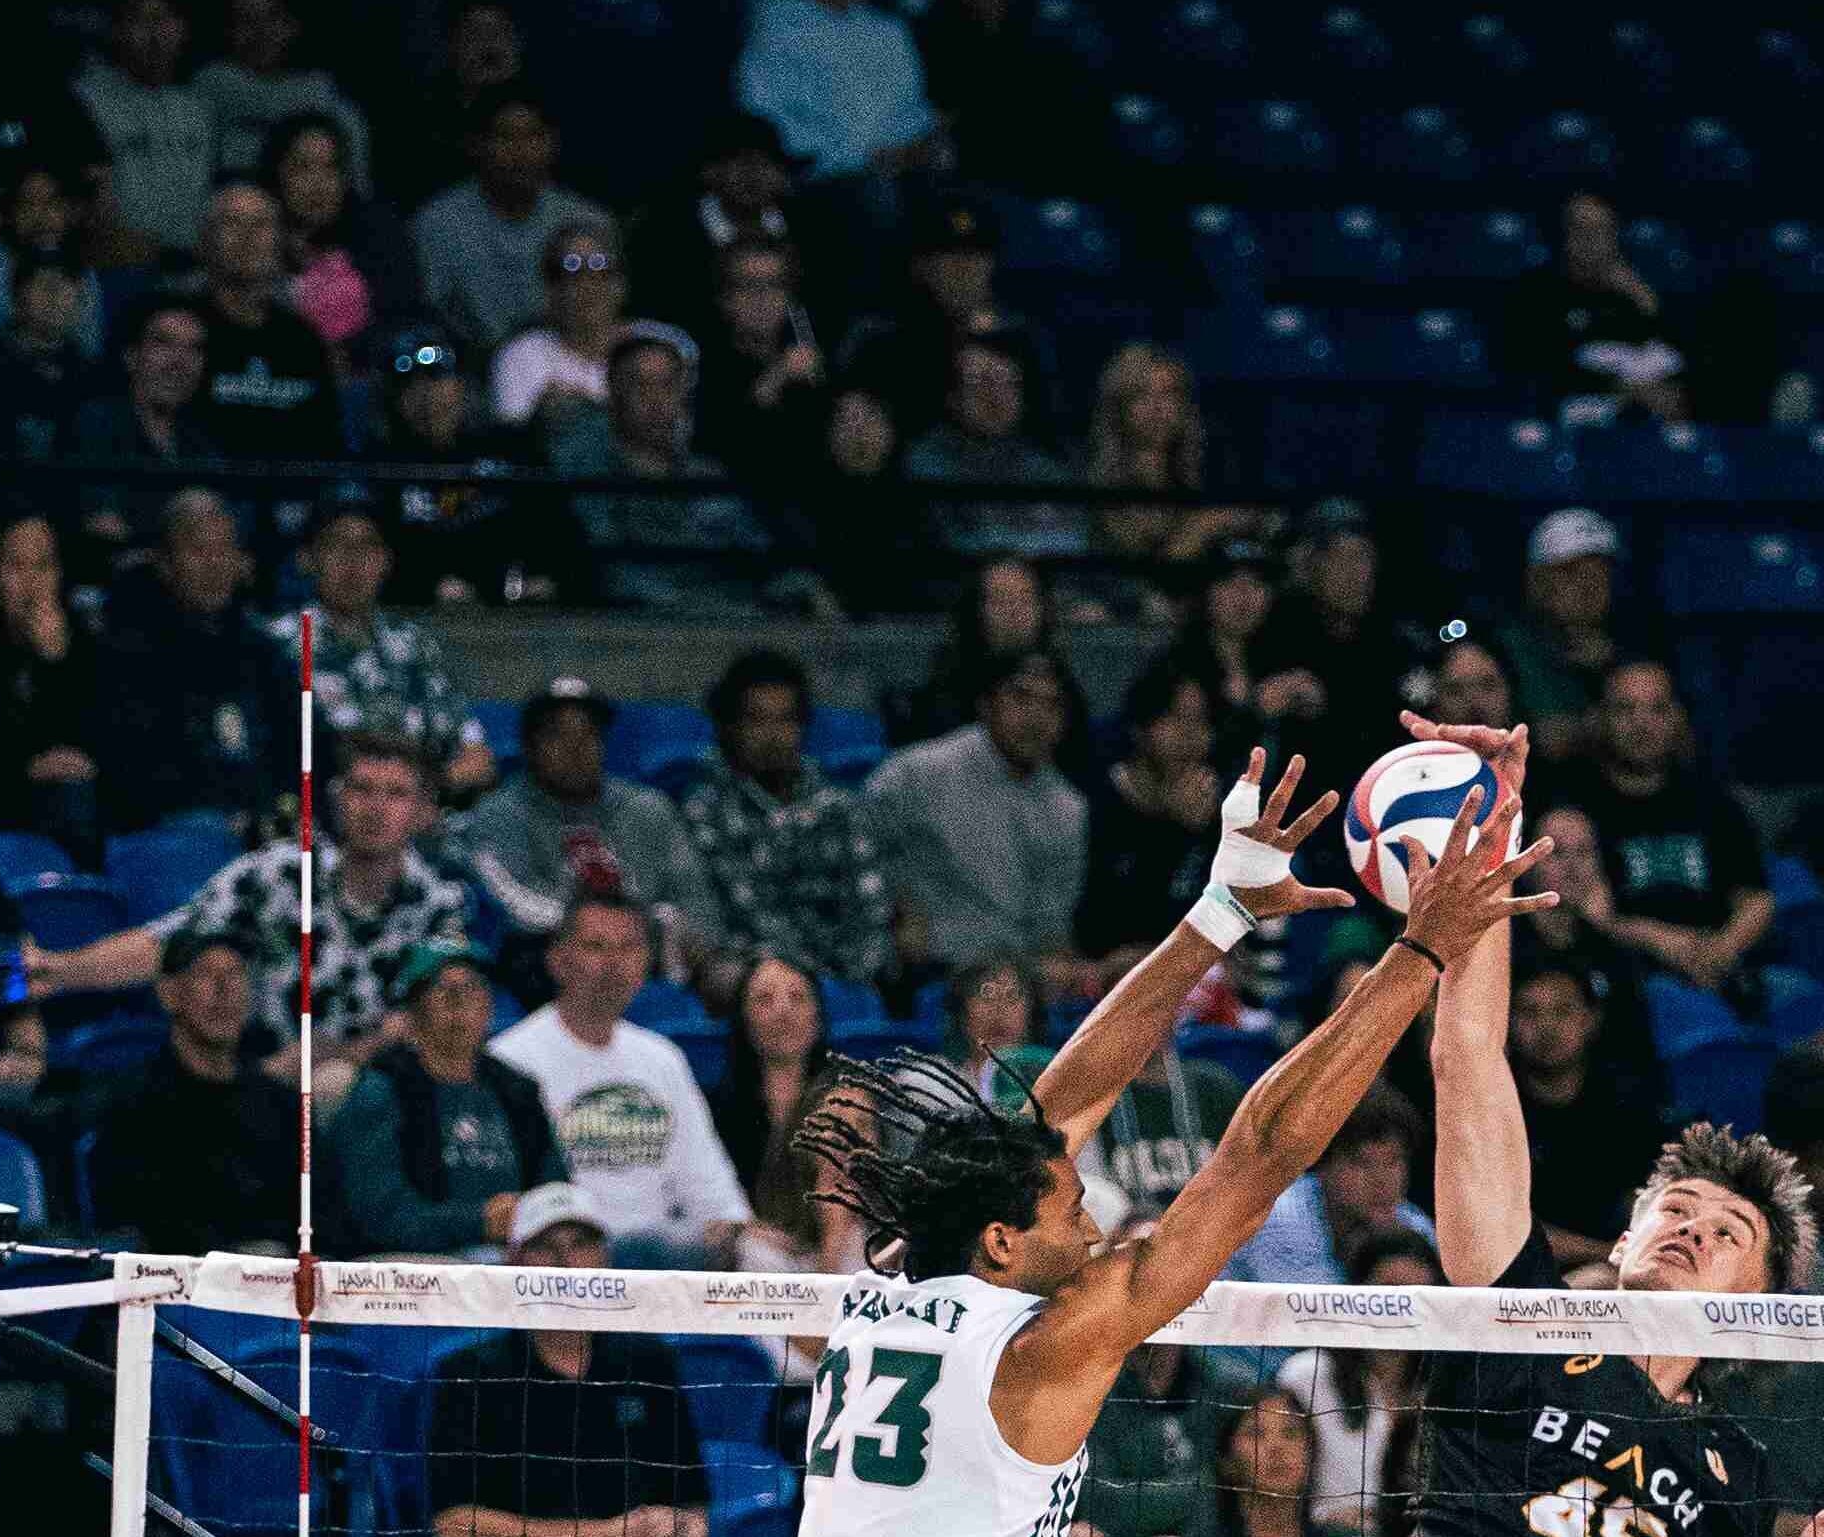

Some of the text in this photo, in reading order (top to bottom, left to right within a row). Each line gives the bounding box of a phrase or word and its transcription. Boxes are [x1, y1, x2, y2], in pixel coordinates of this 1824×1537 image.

[514, 1274, 627, 1300] OUTRIGGER
[1286, 1292, 1414, 1317] OUTRIGGER
[1560, 1297, 1624, 1319] TOURISM
[807, 1346, 944, 1487] 23
[1531, 1404, 1704, 1530] BEACH
